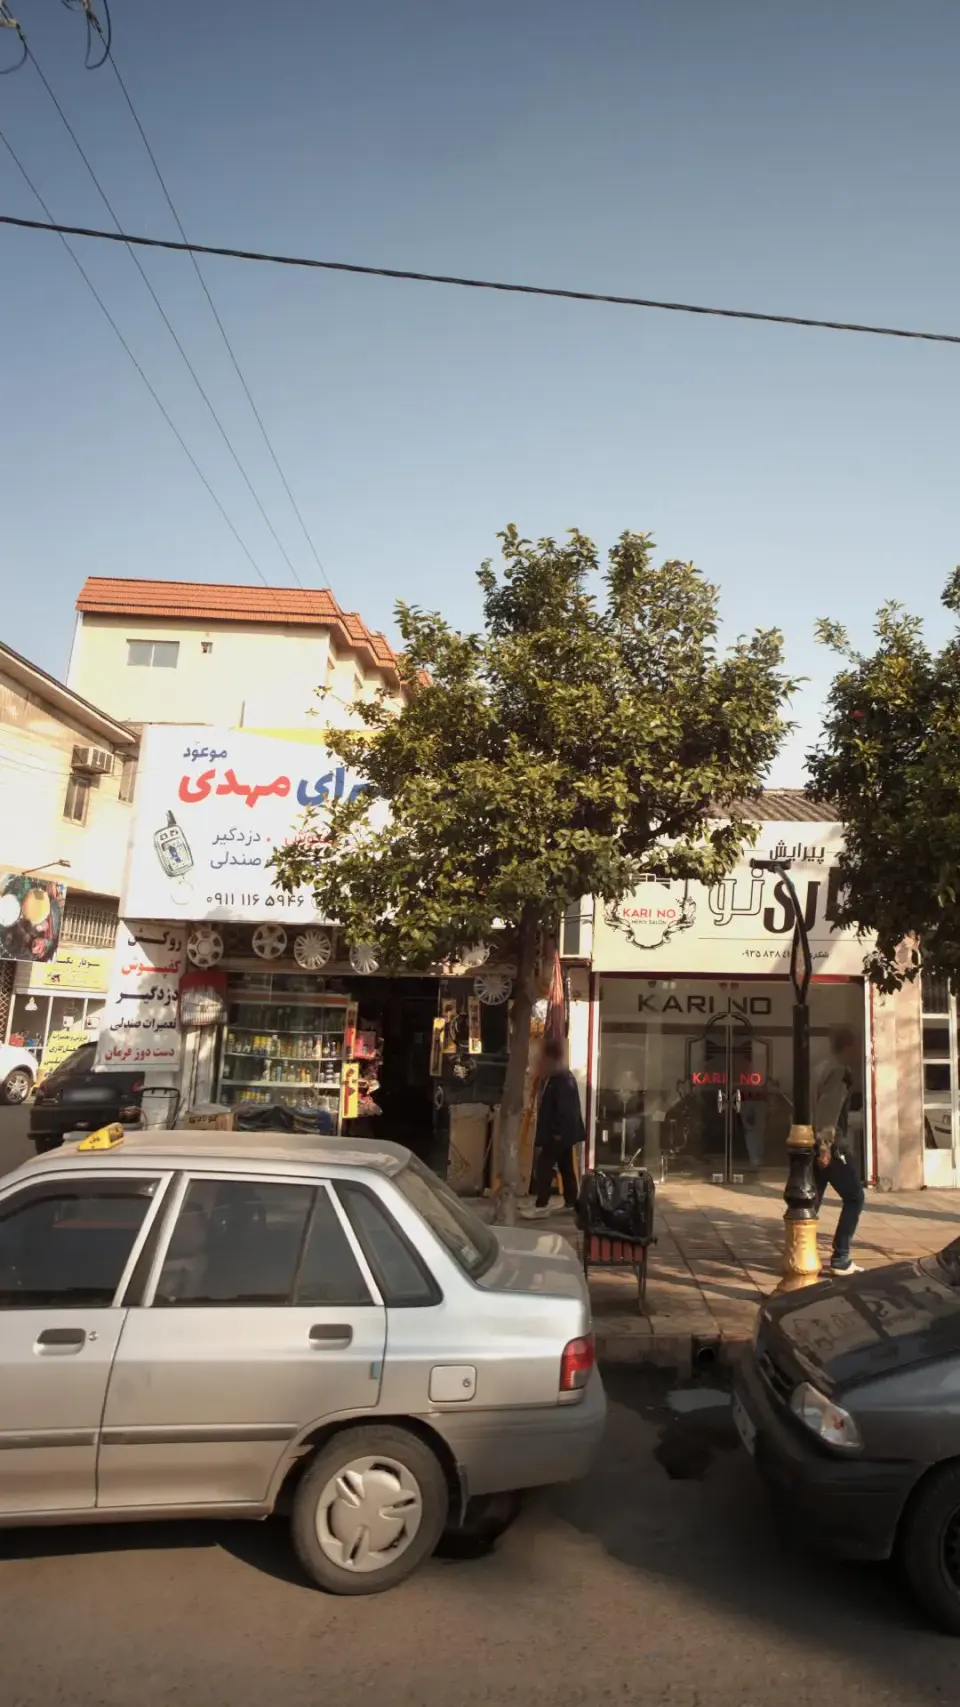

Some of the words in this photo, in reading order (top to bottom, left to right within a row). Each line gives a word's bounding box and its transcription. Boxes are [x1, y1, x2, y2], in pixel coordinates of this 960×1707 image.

[183, 745, 228, 762] موعود
[178, 768, 291, 808] مهدی
[212, 827, 261, 846] دزدگیر
[210, 851, 261, 869] صندلی
[769, 840, 825, 864] پیرایش
[206, 892, 234, 906] ۰۹۱۱
[241, 893, 260, 906] ۱۱۶
[265, 894, 305, 907] ۵۹۴۶
[708, 867, 765, 927] نو
[622, 908, 652, 918] KARI
[657, 908, 676, 918] NO
[128, 928, 182, 952] روکش
[121, 956, 182, 979] کفپوش
[115, 986, 180, 1006] دزدگیر
[638, 994, 714, 1013] KARI
[727, 996, 772, 1015] NO
[110, 1017, 141, 1031] صندلی
[142, 1017, 177, 1032] تعمیرات
[104, 1046, 132, 1061] فرمان
[152, 1047, 175, 1057] دست
[692, 1072, 726, 1085] KARI
[740, 1072, 762, 1085] NO
